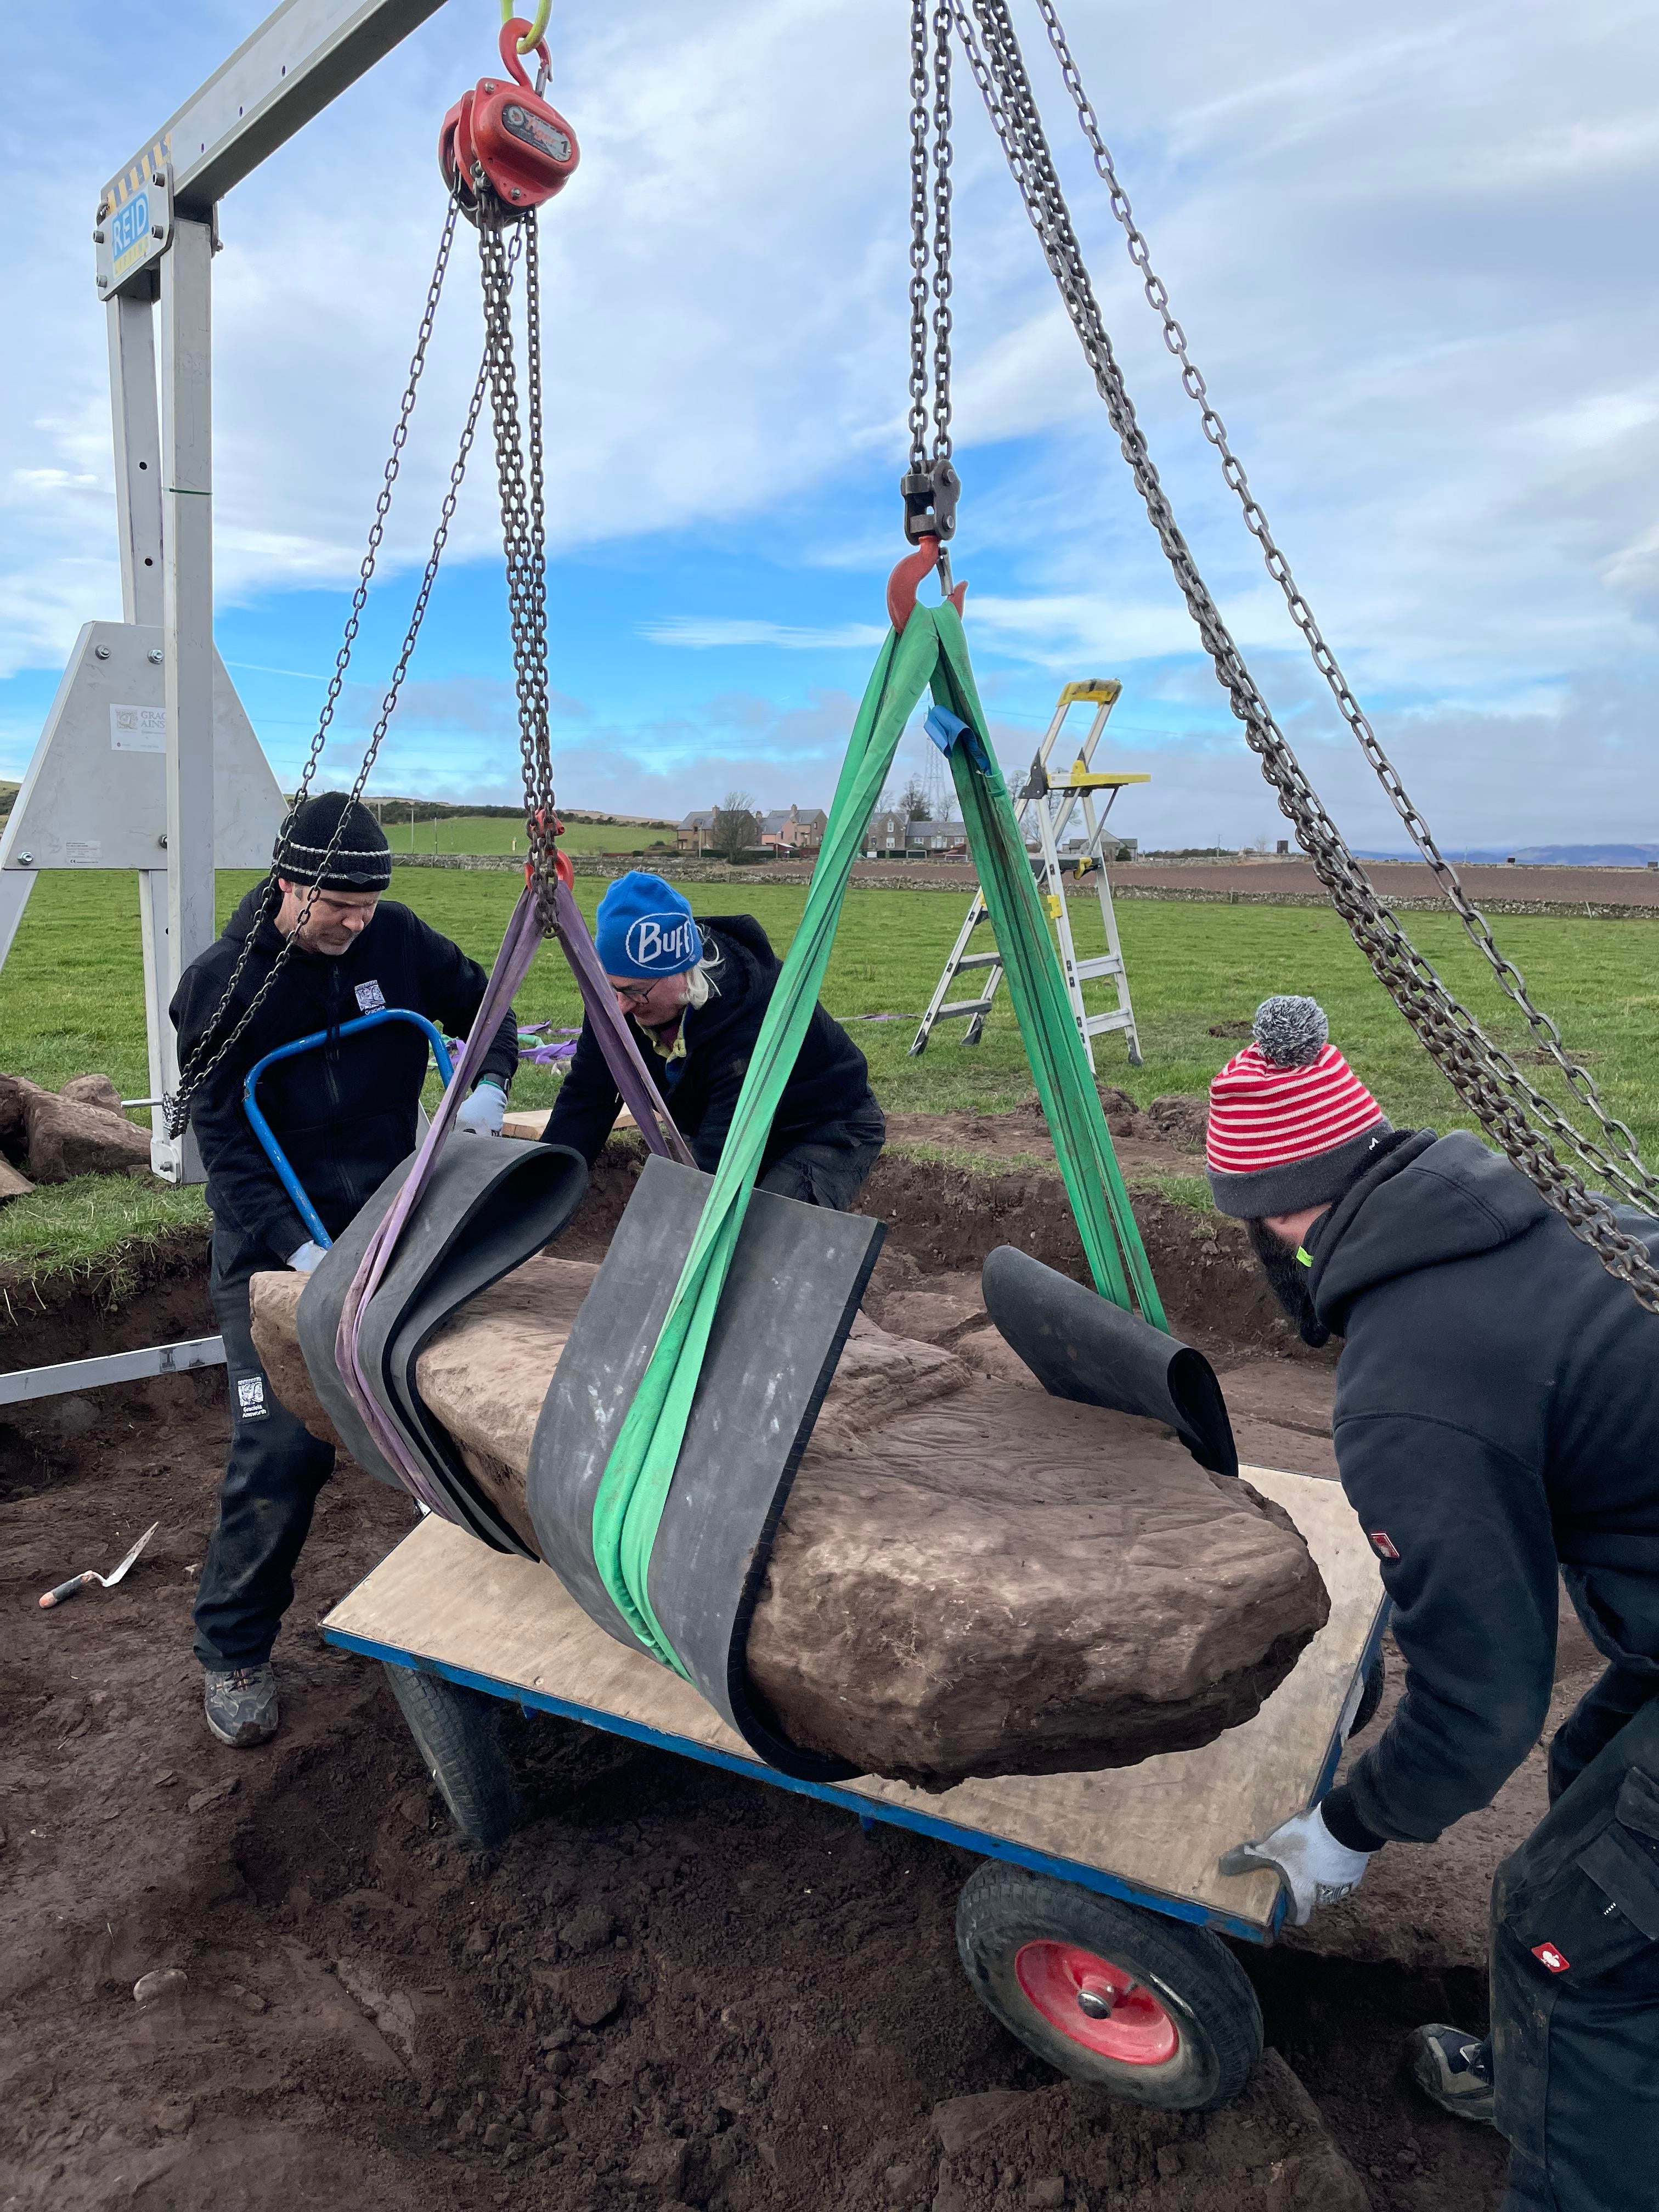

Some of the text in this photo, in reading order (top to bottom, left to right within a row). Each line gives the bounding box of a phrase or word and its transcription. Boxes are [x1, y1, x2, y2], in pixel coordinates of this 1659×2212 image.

[561, 140, 568, 154] 1
[114, 198, 146, 256] REID
[242, 1409, 267, 1418] Ainsworth
[243, 1404, 263, 1413] Graciela
